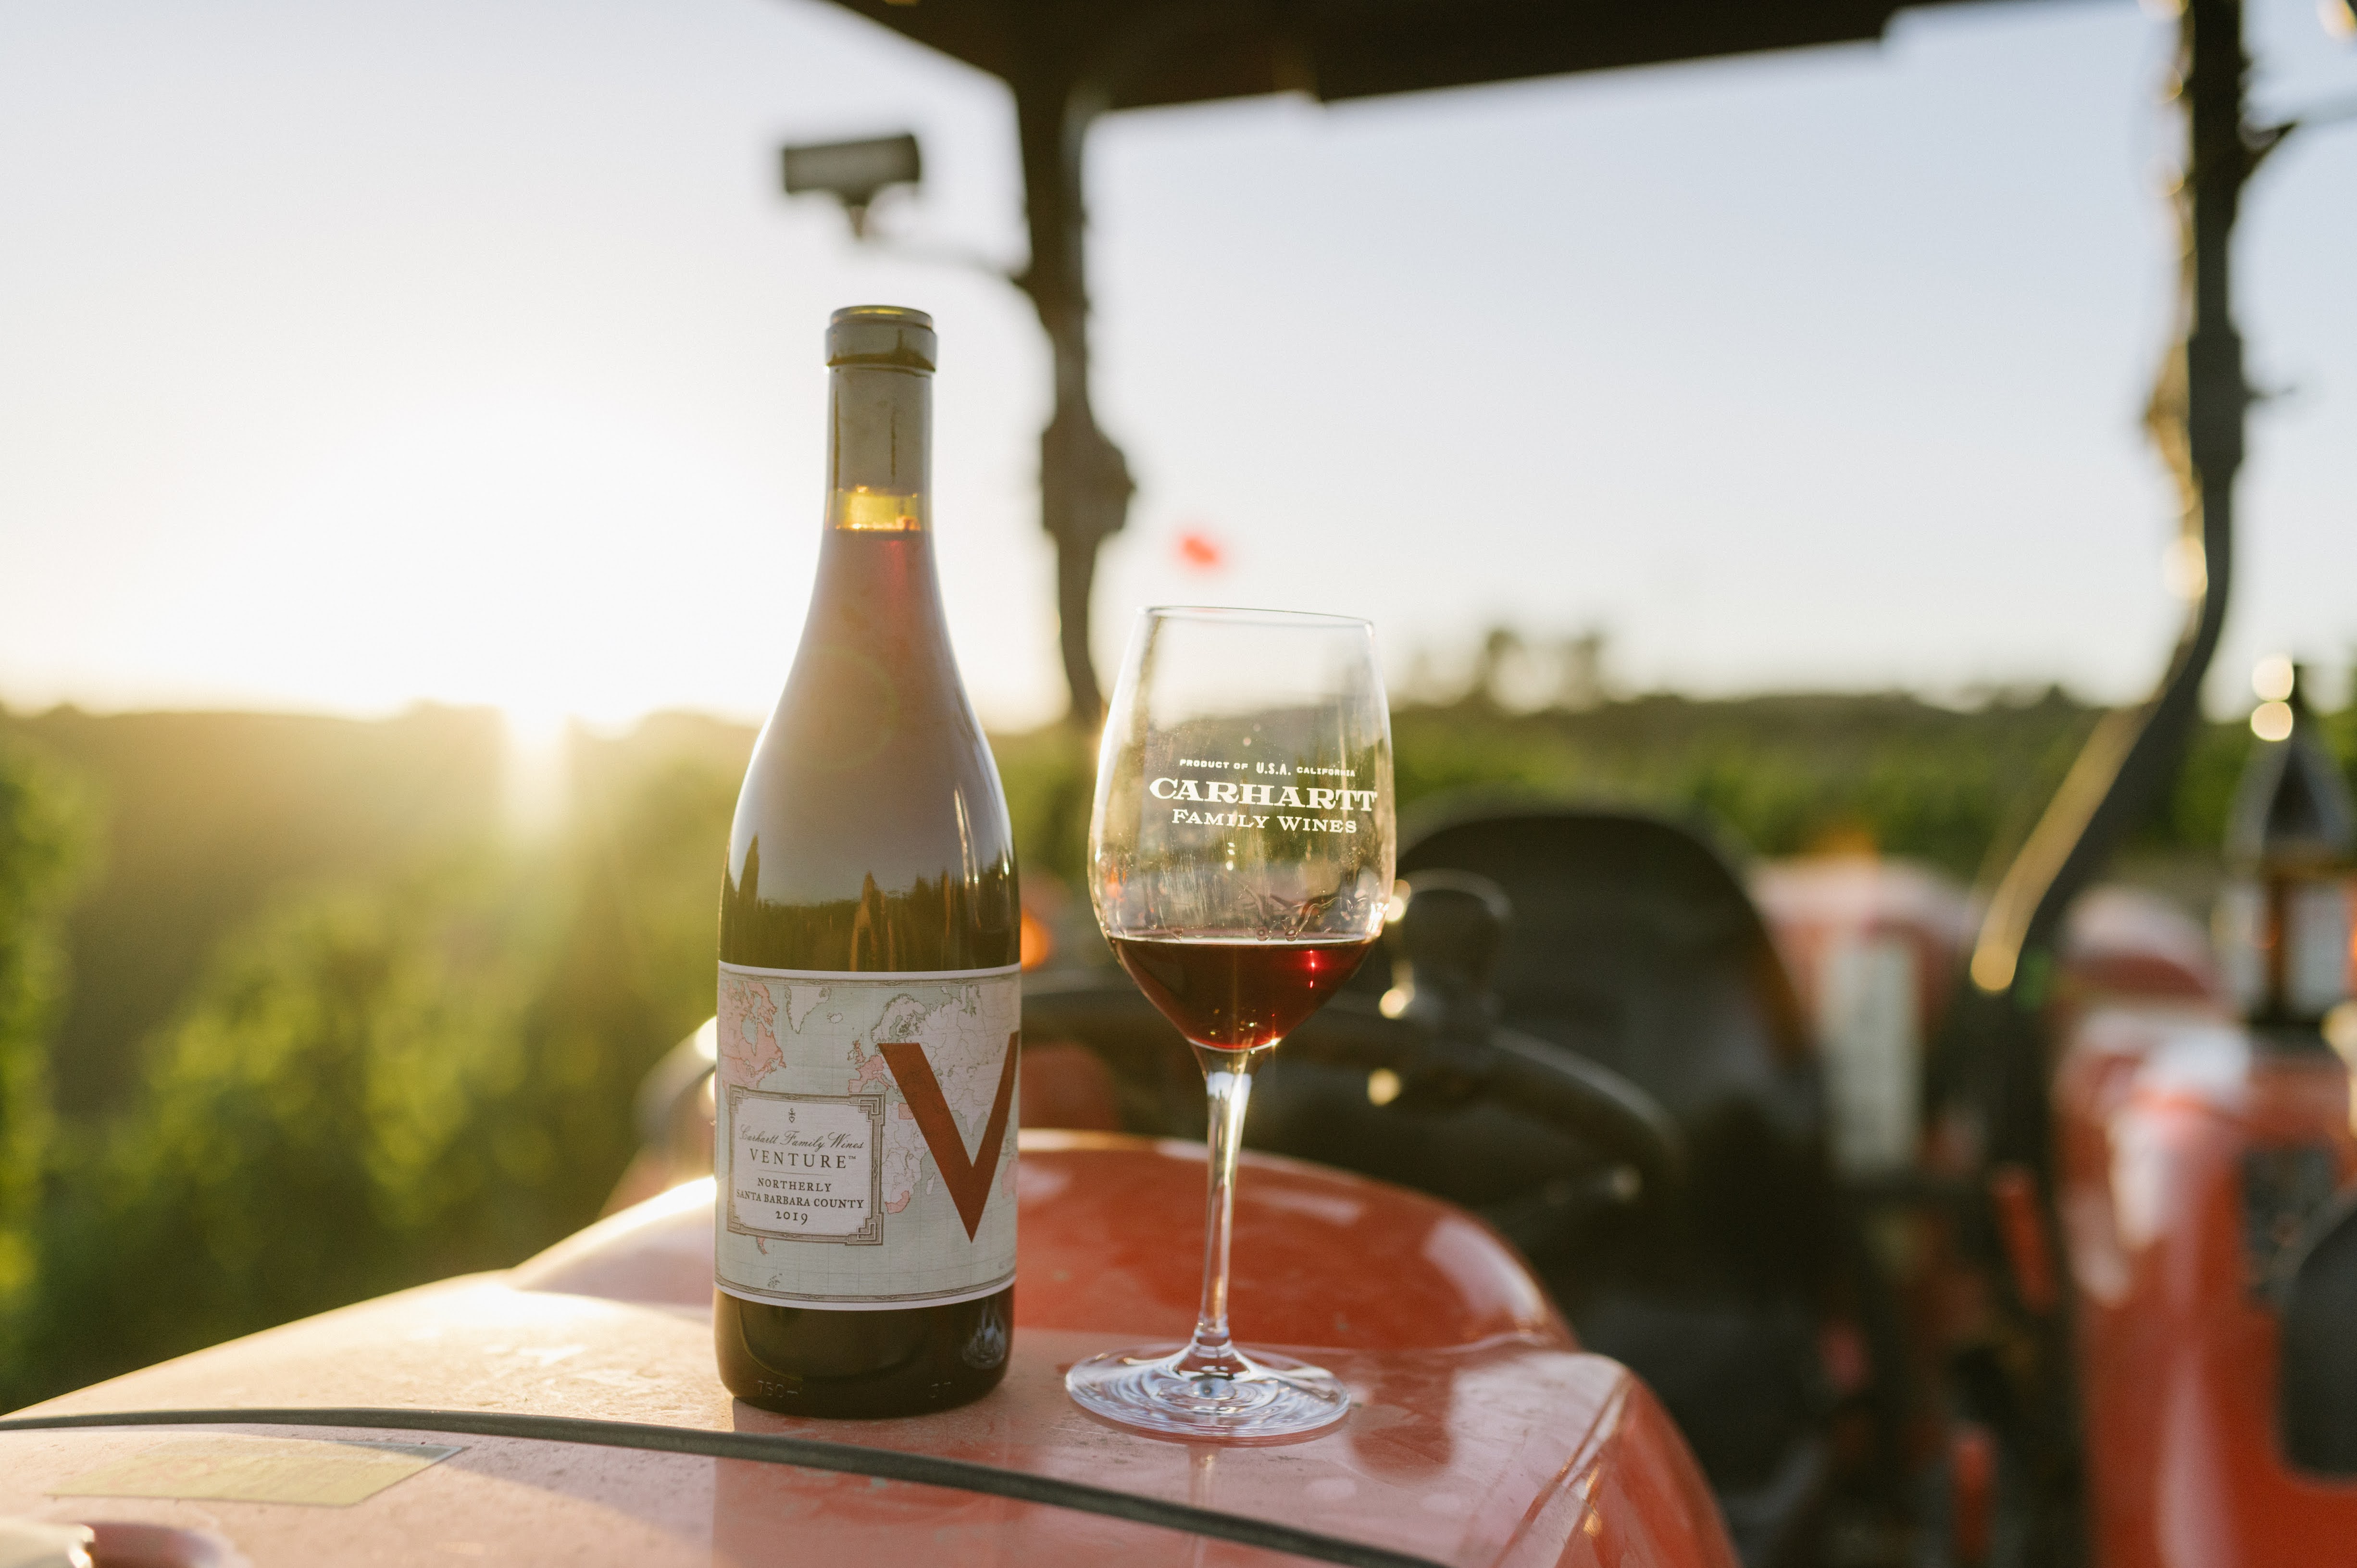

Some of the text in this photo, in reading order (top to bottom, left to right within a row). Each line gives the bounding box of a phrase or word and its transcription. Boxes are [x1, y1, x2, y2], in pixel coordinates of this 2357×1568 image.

[1180, 759, 1230, 769] PRODUCT
[1256, 762, 1291, 775] U.S.A.
[1297, 766, 1355, 777] CALIFORNIA
[1149, 777, 1378, 811] CARHARTT
[1172, 809, 1357, 834] FAMILY WINES
[738, 1124, 864, 1152] Carhartt Family Wines
[758, 1178, 832, 1192] NORTHERLY
[736, 1189, 864, 1208] SANTA BARBARA COUNTY
[775, 1211, 808, 1225] 2019
